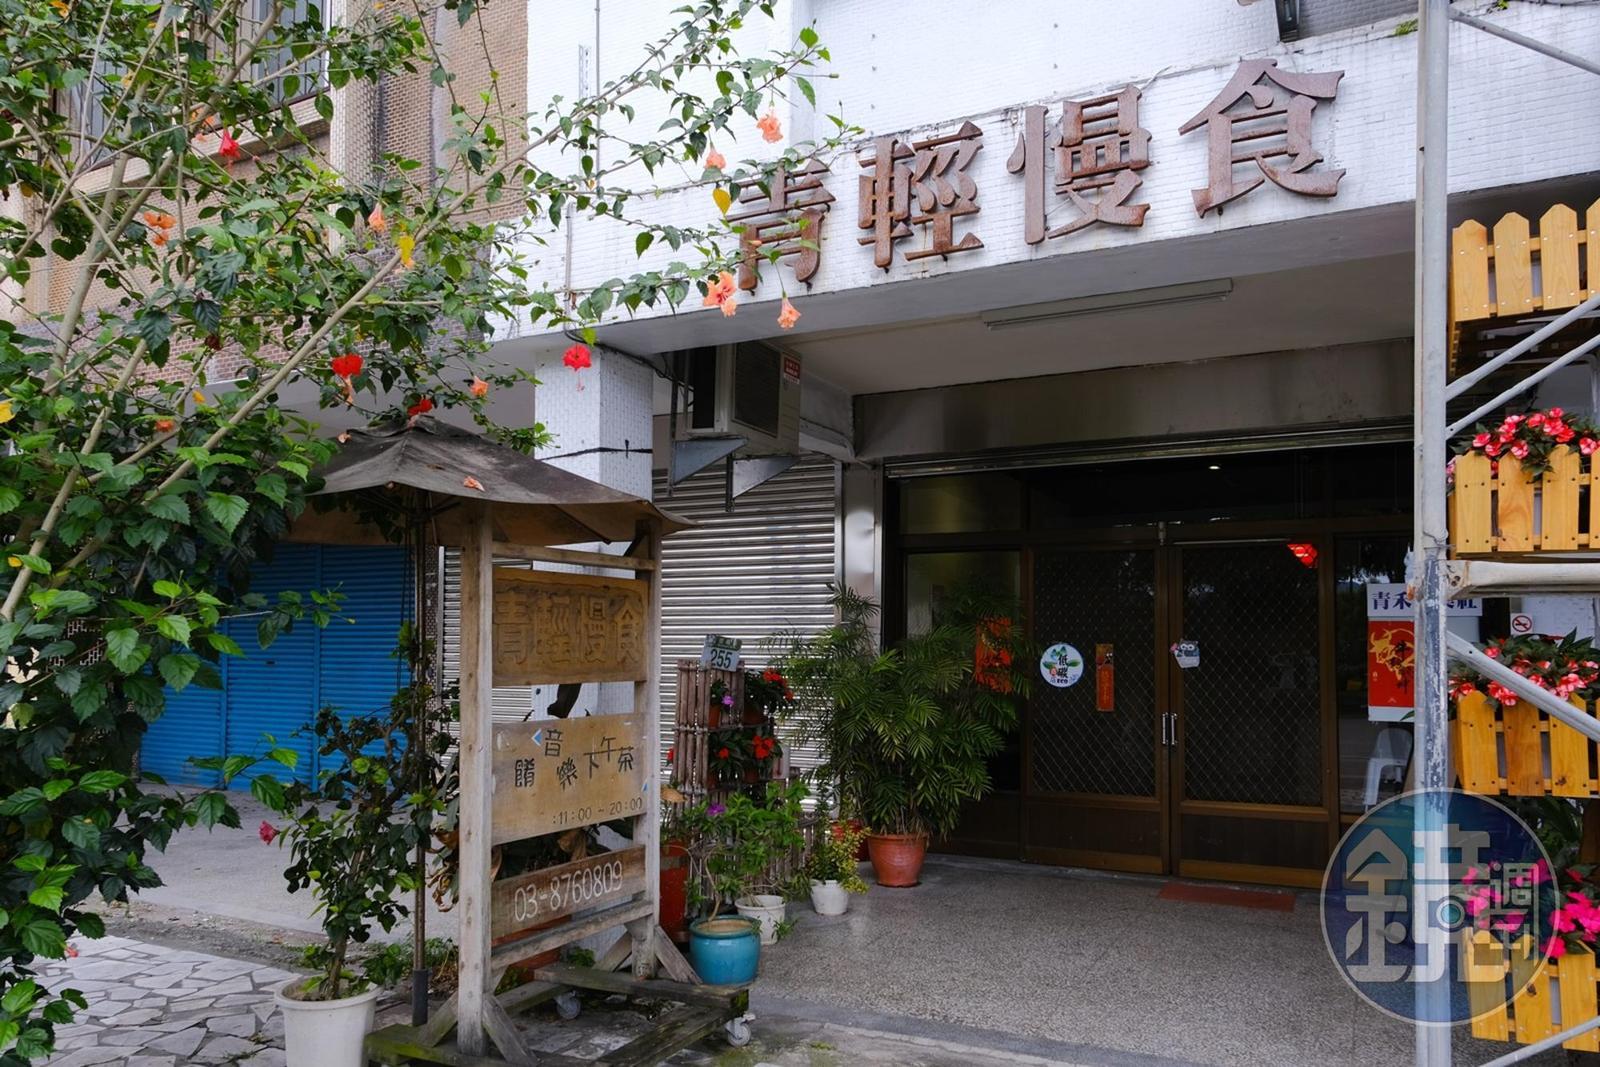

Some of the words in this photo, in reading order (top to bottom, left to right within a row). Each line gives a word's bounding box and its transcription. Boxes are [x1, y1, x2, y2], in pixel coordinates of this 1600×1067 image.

[727, 58, 1347, 290] 青輕慢食
[710, 648, 733, 668] 255
[609, 797, 643, 815] 20:00
[514, 860, 623, 922] 03-8760809
